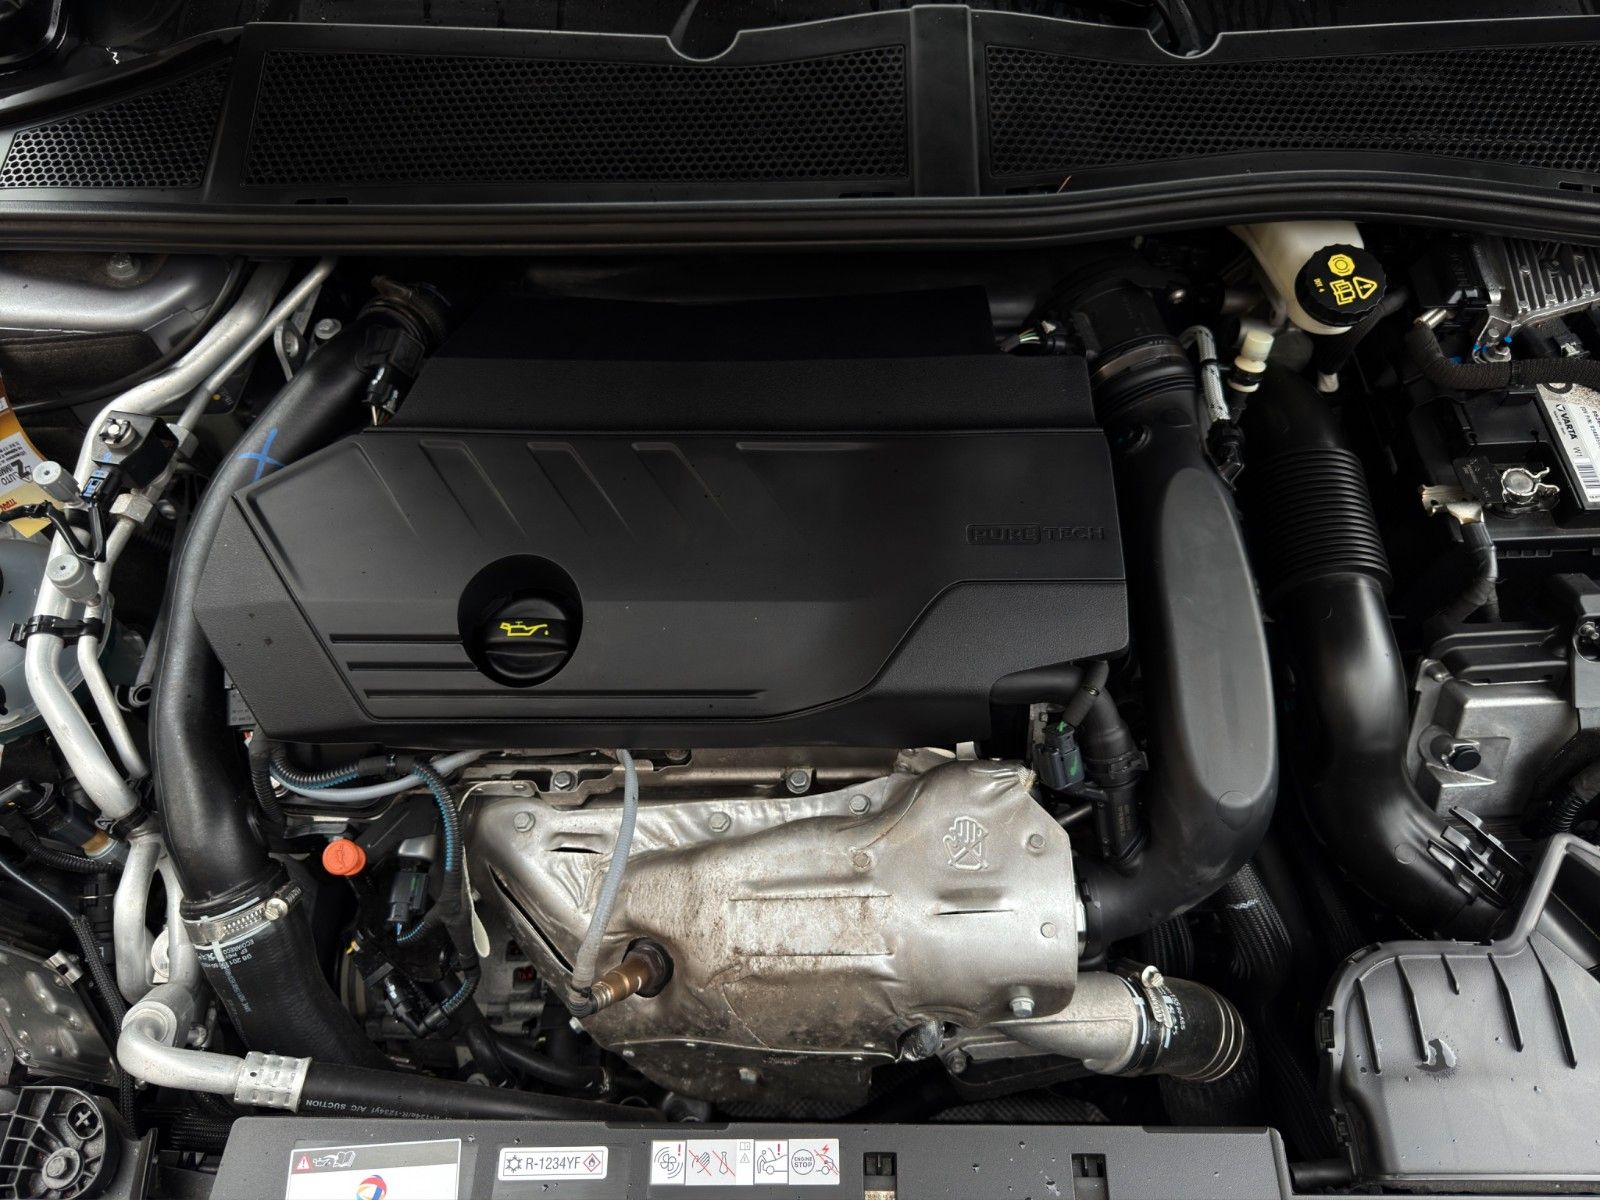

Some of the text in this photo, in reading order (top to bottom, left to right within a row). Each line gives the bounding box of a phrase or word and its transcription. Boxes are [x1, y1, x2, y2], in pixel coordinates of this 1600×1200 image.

[1561, 411, 1578, 440] VARTA
[306, 1099, 347, 1110] SUCTION
[525, 1156, 581, 1170] R-1234YF
